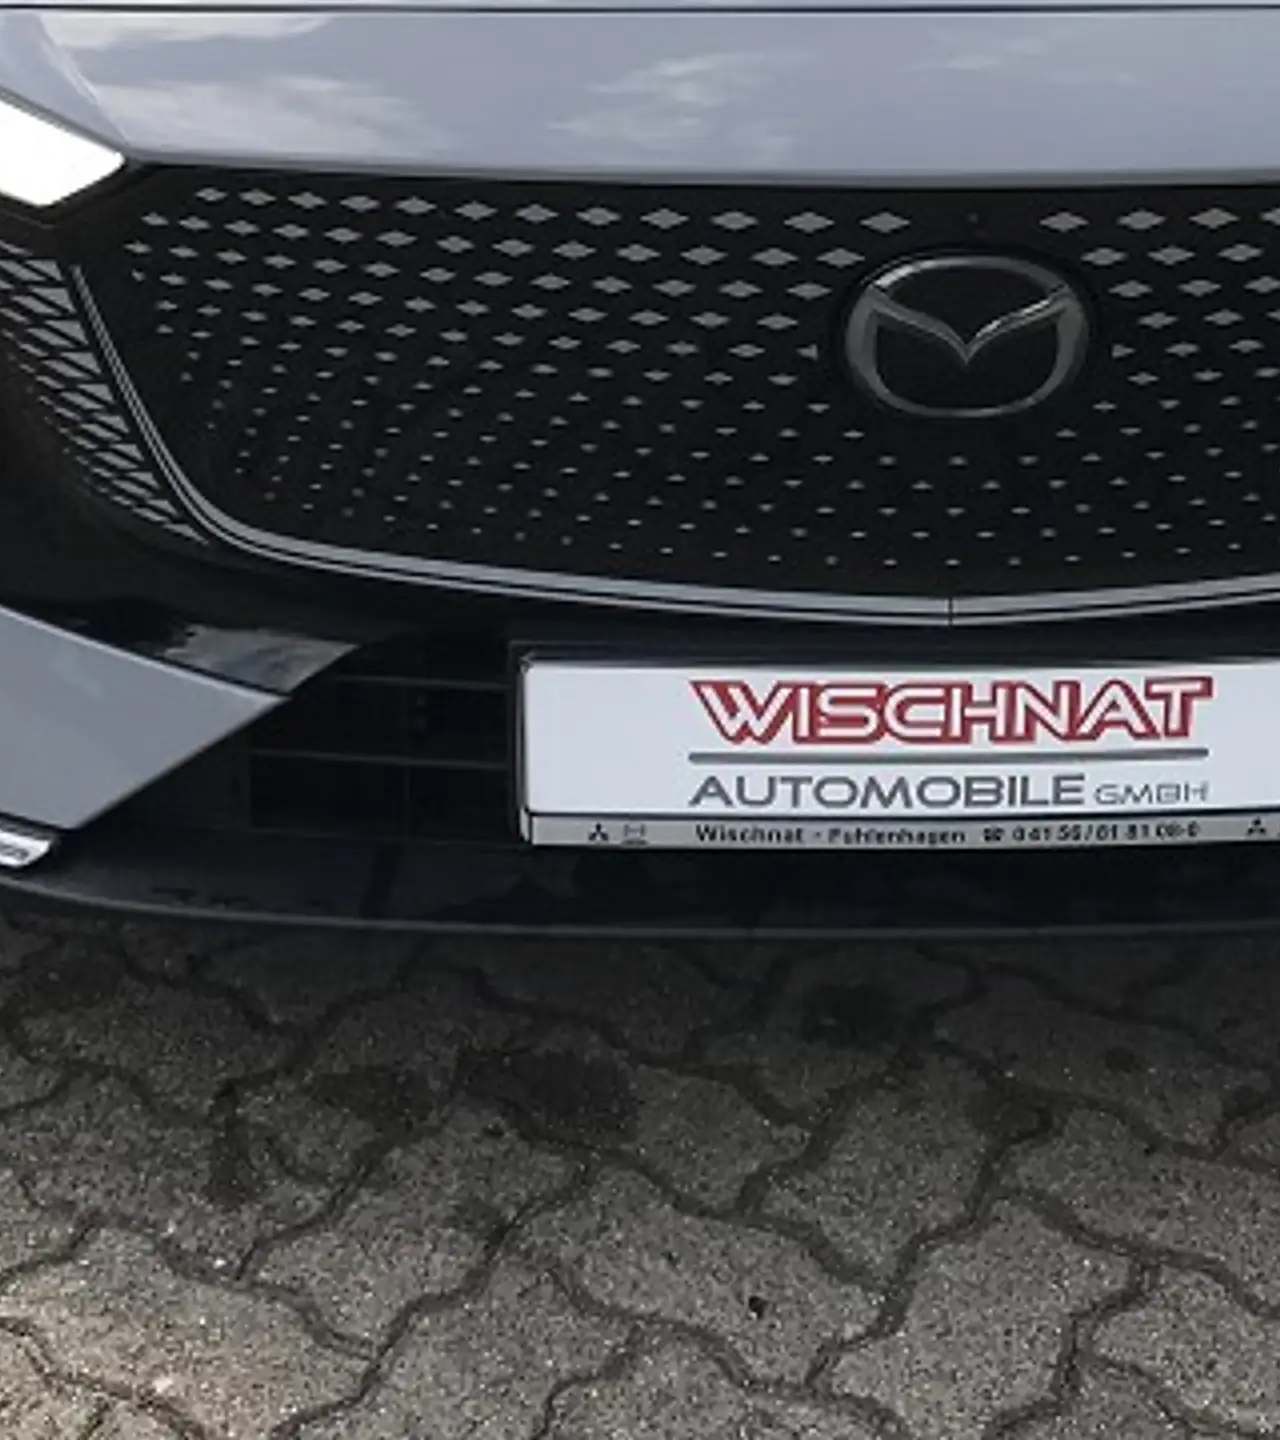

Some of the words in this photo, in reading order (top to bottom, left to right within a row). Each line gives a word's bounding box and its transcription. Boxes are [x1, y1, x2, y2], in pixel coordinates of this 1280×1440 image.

[689, 676, 1213, 745] WISCHNAT
[689, 774, 1085, 809] AUTOMOBILE
[1093, 781, 1208, 806] GMBH
[695, 824, 805, 844] Wischnat
